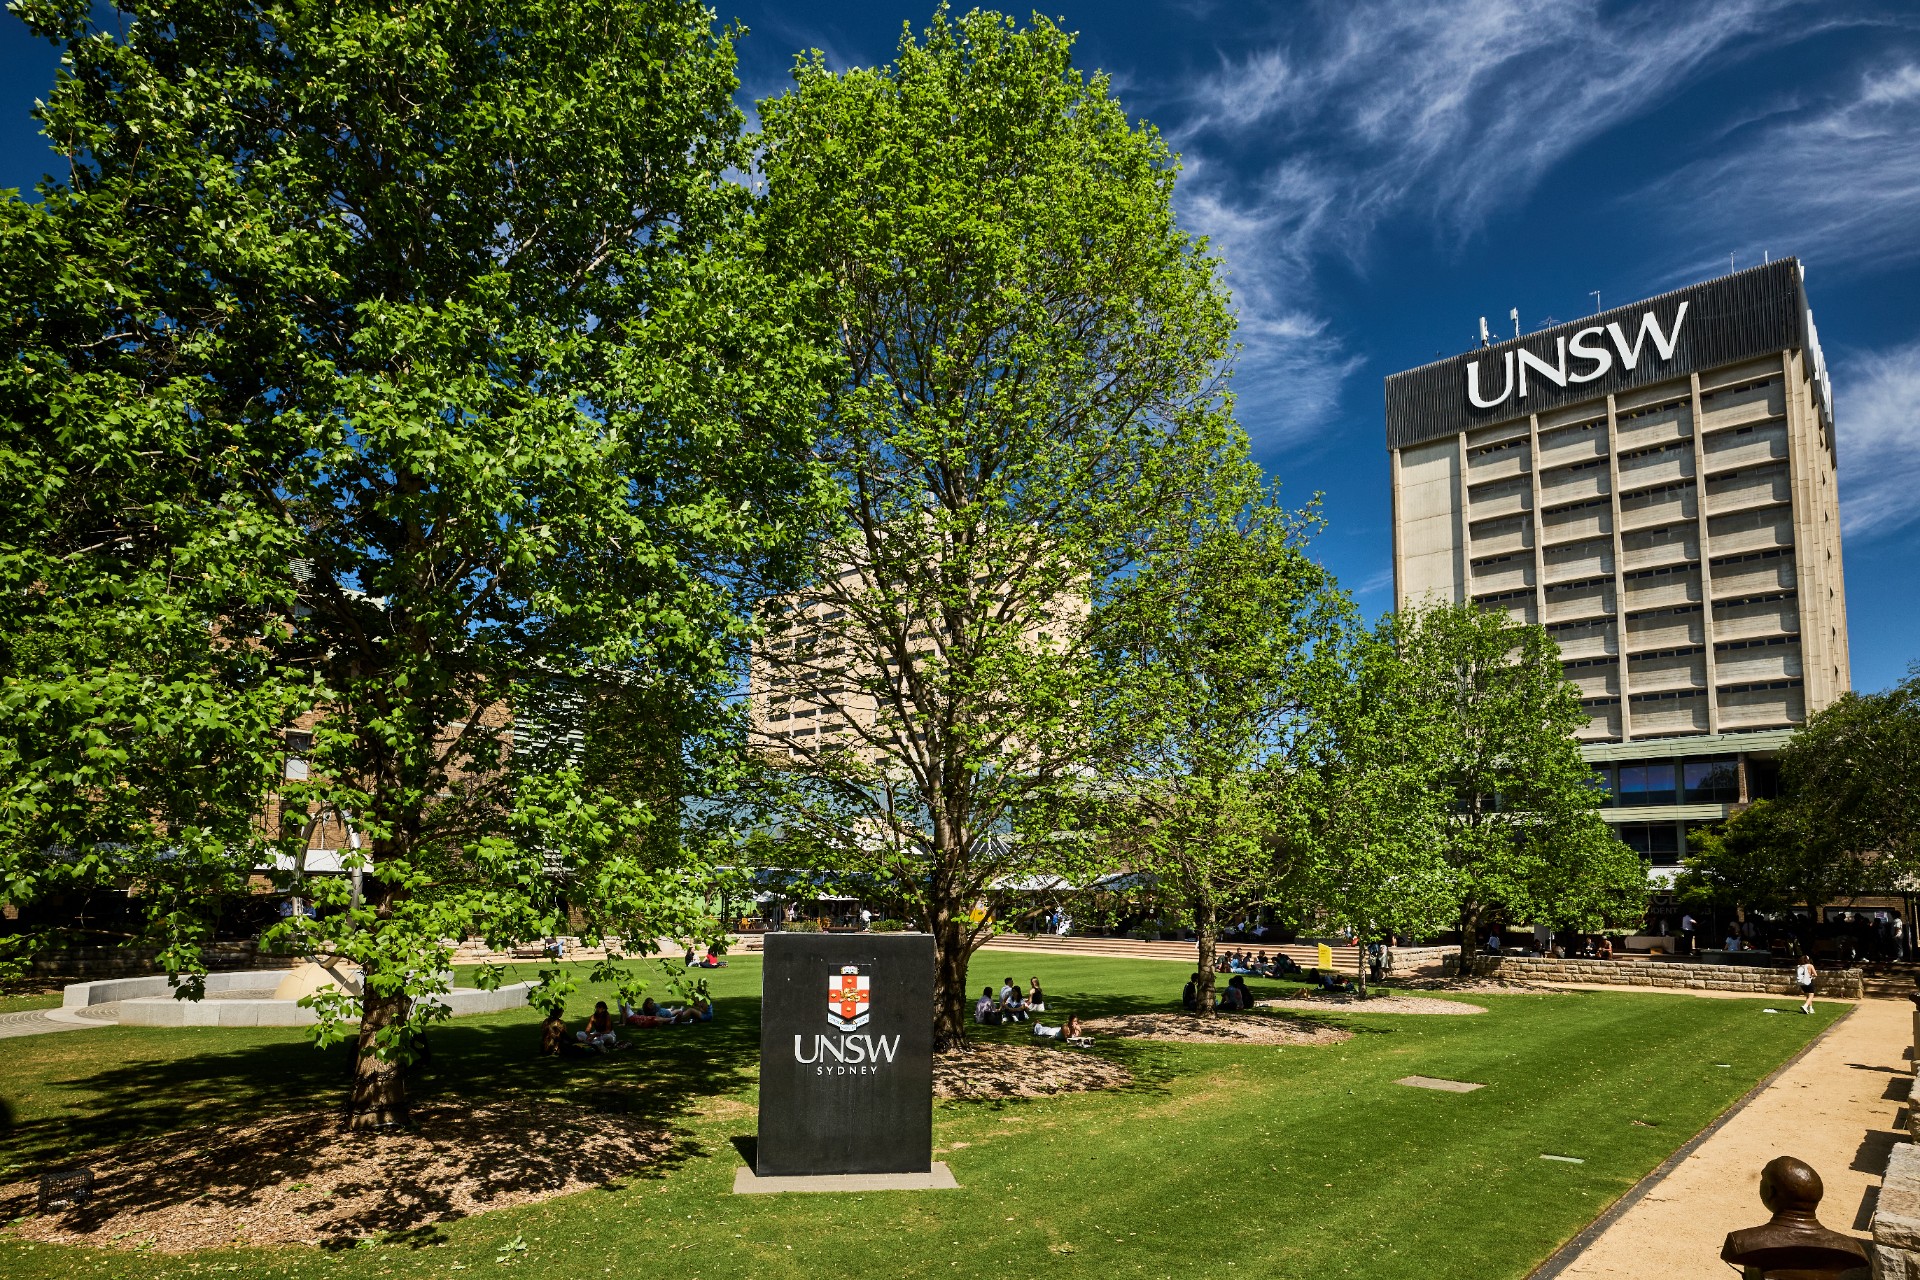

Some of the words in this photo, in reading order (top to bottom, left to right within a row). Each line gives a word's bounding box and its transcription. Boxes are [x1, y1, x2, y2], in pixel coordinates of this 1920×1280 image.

[1467, 301, 1689, 408] UNSW
[794, 1035, 901, 1064] UNSW
[816, 1066, 878, 1076] SYDNEY
